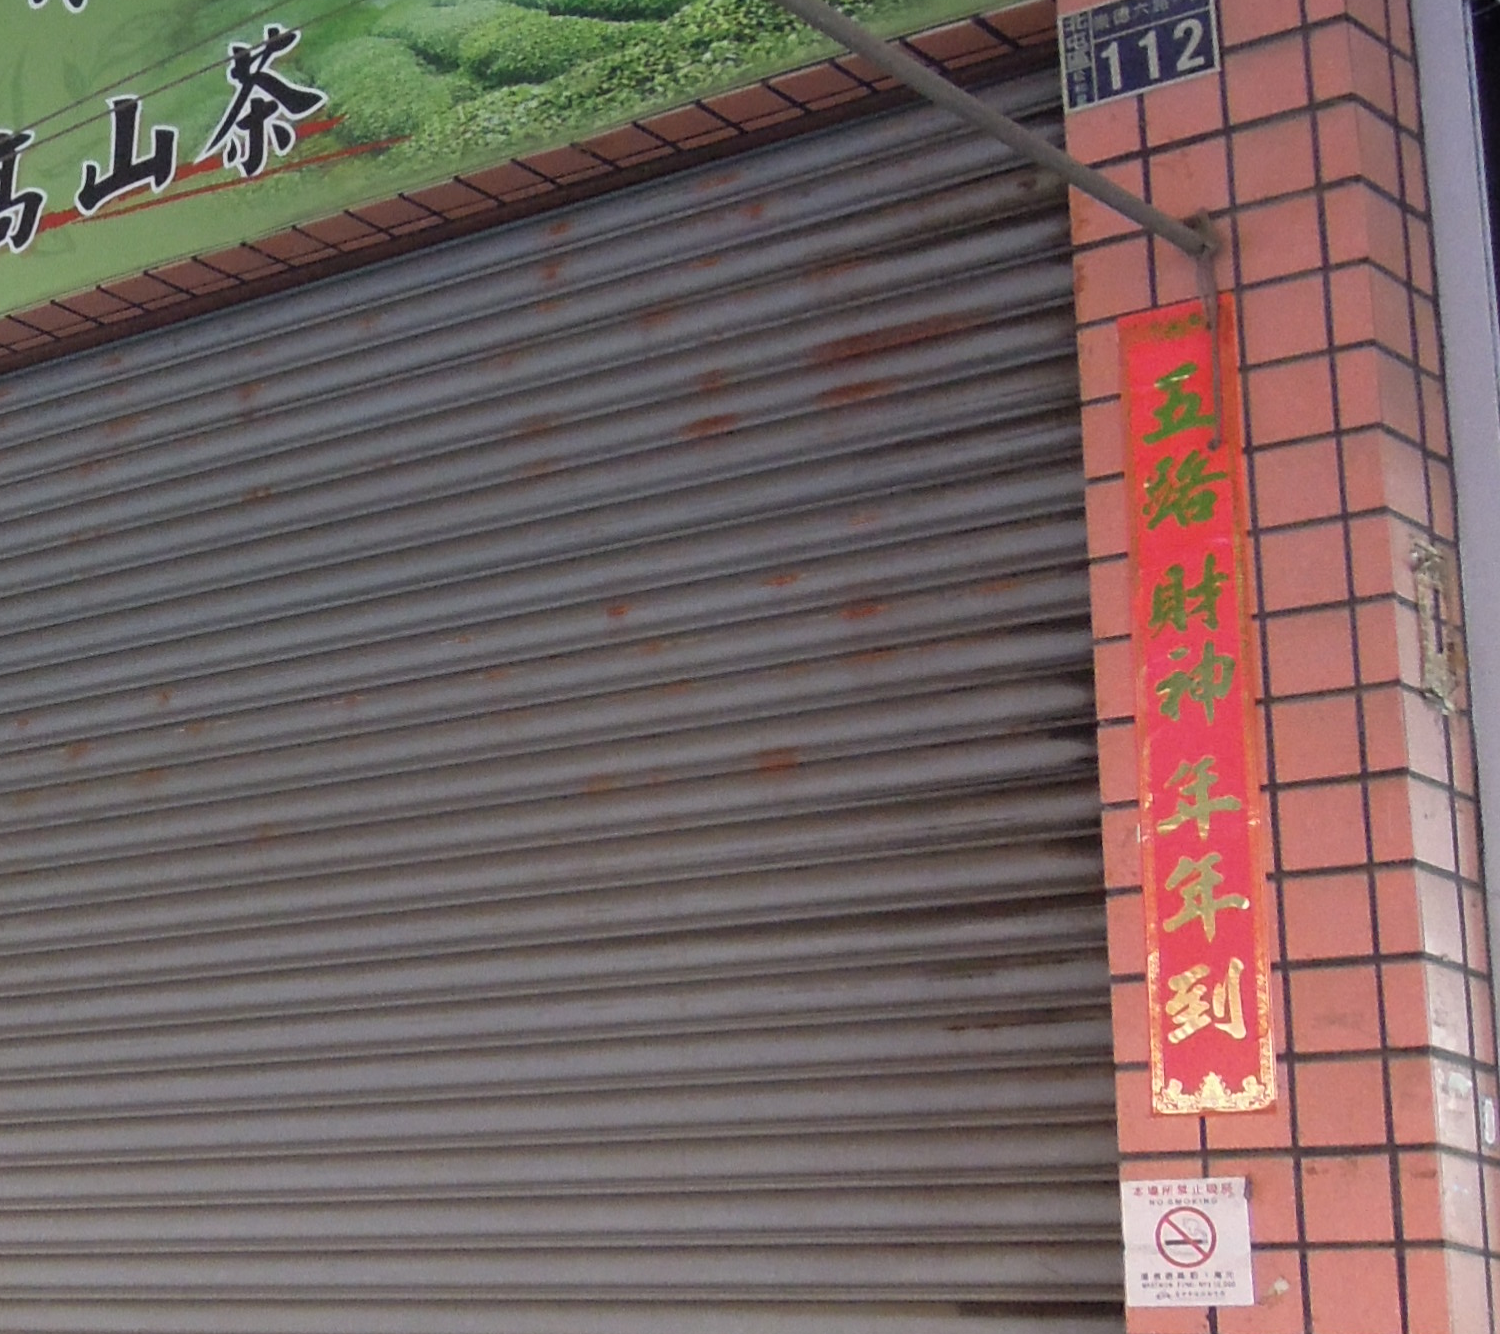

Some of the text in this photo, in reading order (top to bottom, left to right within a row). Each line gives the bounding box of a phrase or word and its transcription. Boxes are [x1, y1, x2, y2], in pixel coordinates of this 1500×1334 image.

[1101, 18, 1205, 90] 112
[1143, 362, 1250, 1045] 五路財神年年到
